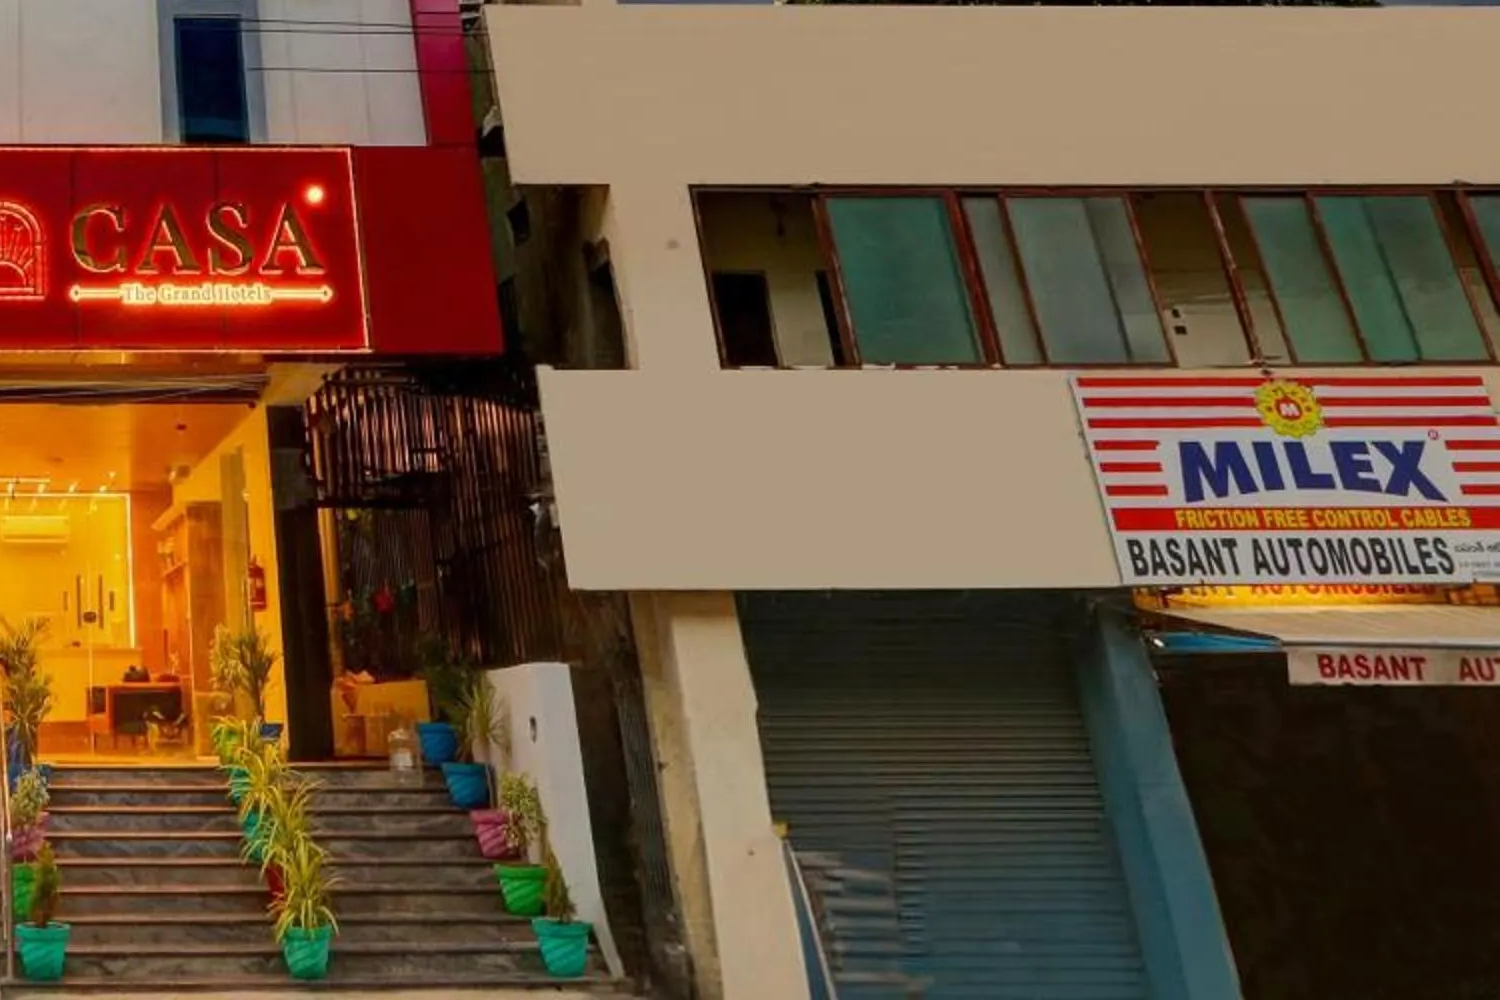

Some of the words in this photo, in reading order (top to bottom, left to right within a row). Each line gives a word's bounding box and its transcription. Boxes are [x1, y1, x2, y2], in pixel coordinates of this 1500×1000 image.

[69, 202, 325, 276] CASA
[122, 284, 156, 303] The
[159, 284, 211, 303] Grand
[213, 284, 273, 303] Hotels
[1178, 439, 1449, 502] MILEX
[1175, 508, 1259, 528] FRICTION
[1262, 508, 1308, 528] FREE
[1312, 508, 1398, 528] CONTROL
[1401, 508, 1471, 528] CABLES
[1126, 538, 1240, 577] BASANT
[1252, 537, 1454, 576] AUTOMOBILES
[1317, 654, 1426, 680] BASANT
